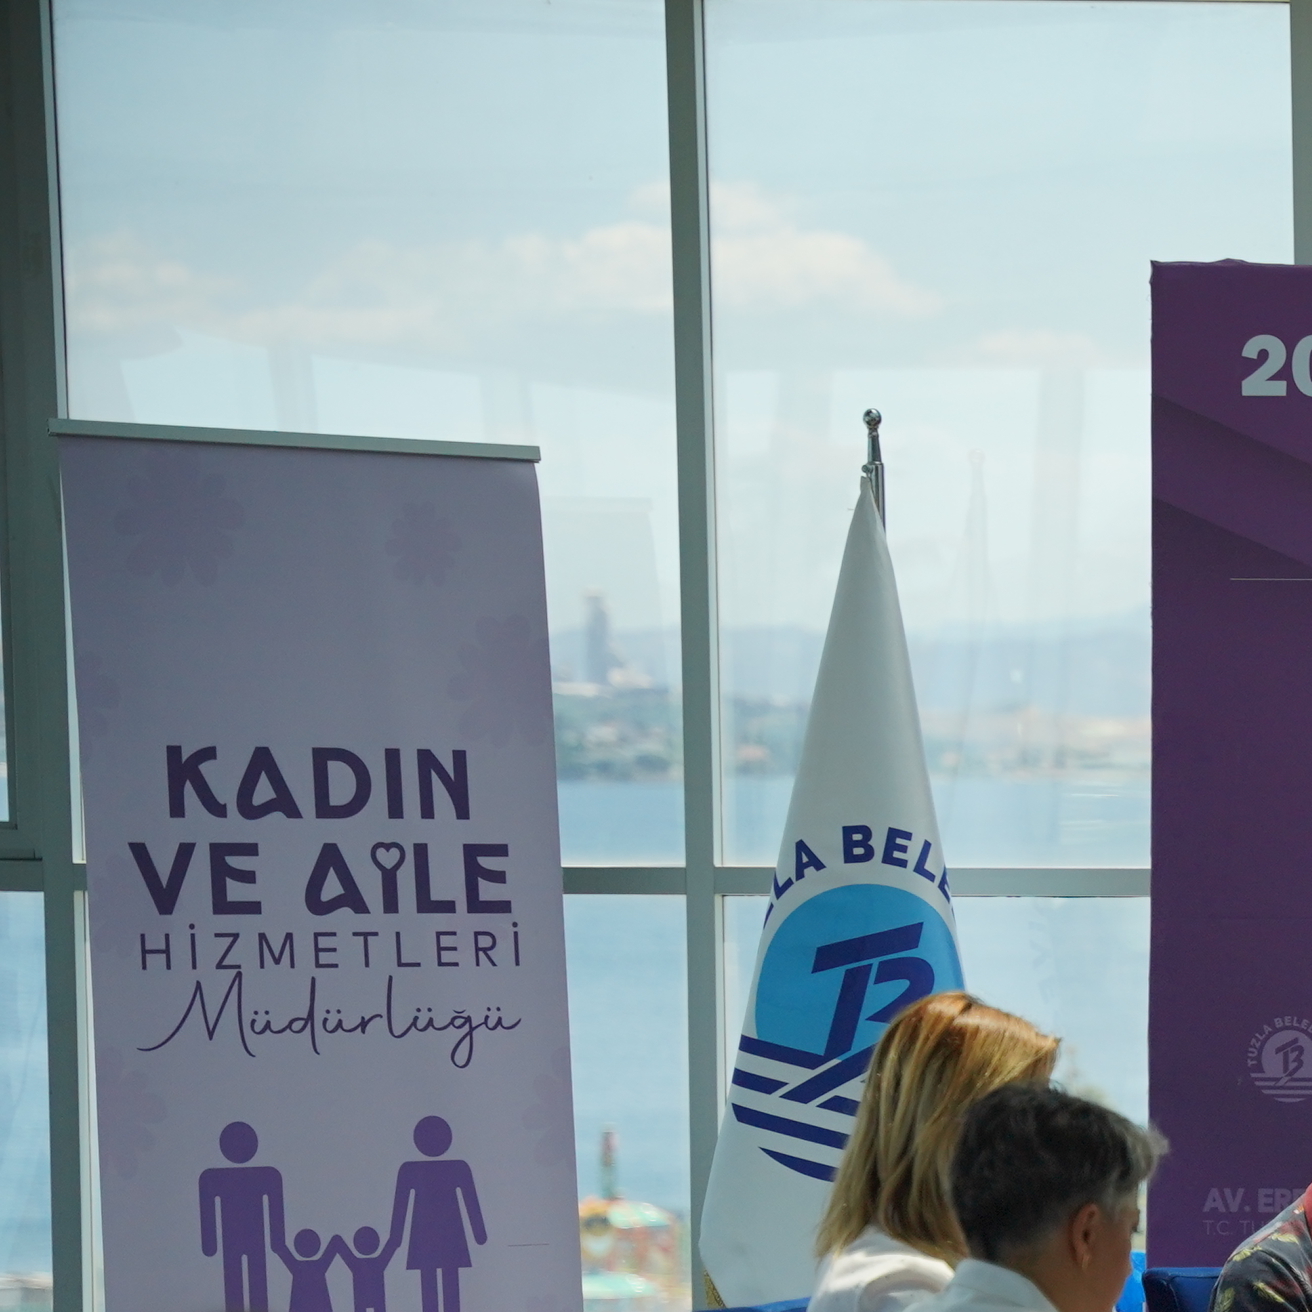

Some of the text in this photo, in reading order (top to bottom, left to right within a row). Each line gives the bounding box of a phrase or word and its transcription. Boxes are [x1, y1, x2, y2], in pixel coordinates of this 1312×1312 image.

[165, 744, 471, 821] KADIN
[127, 841, 263, 916] VE
[139, 921, 521, 972] HİZMETLERİ
[136, 970, 522, 1069] Müdürlüğü
[1247, 1024, 1273, 1067] TUZLA
